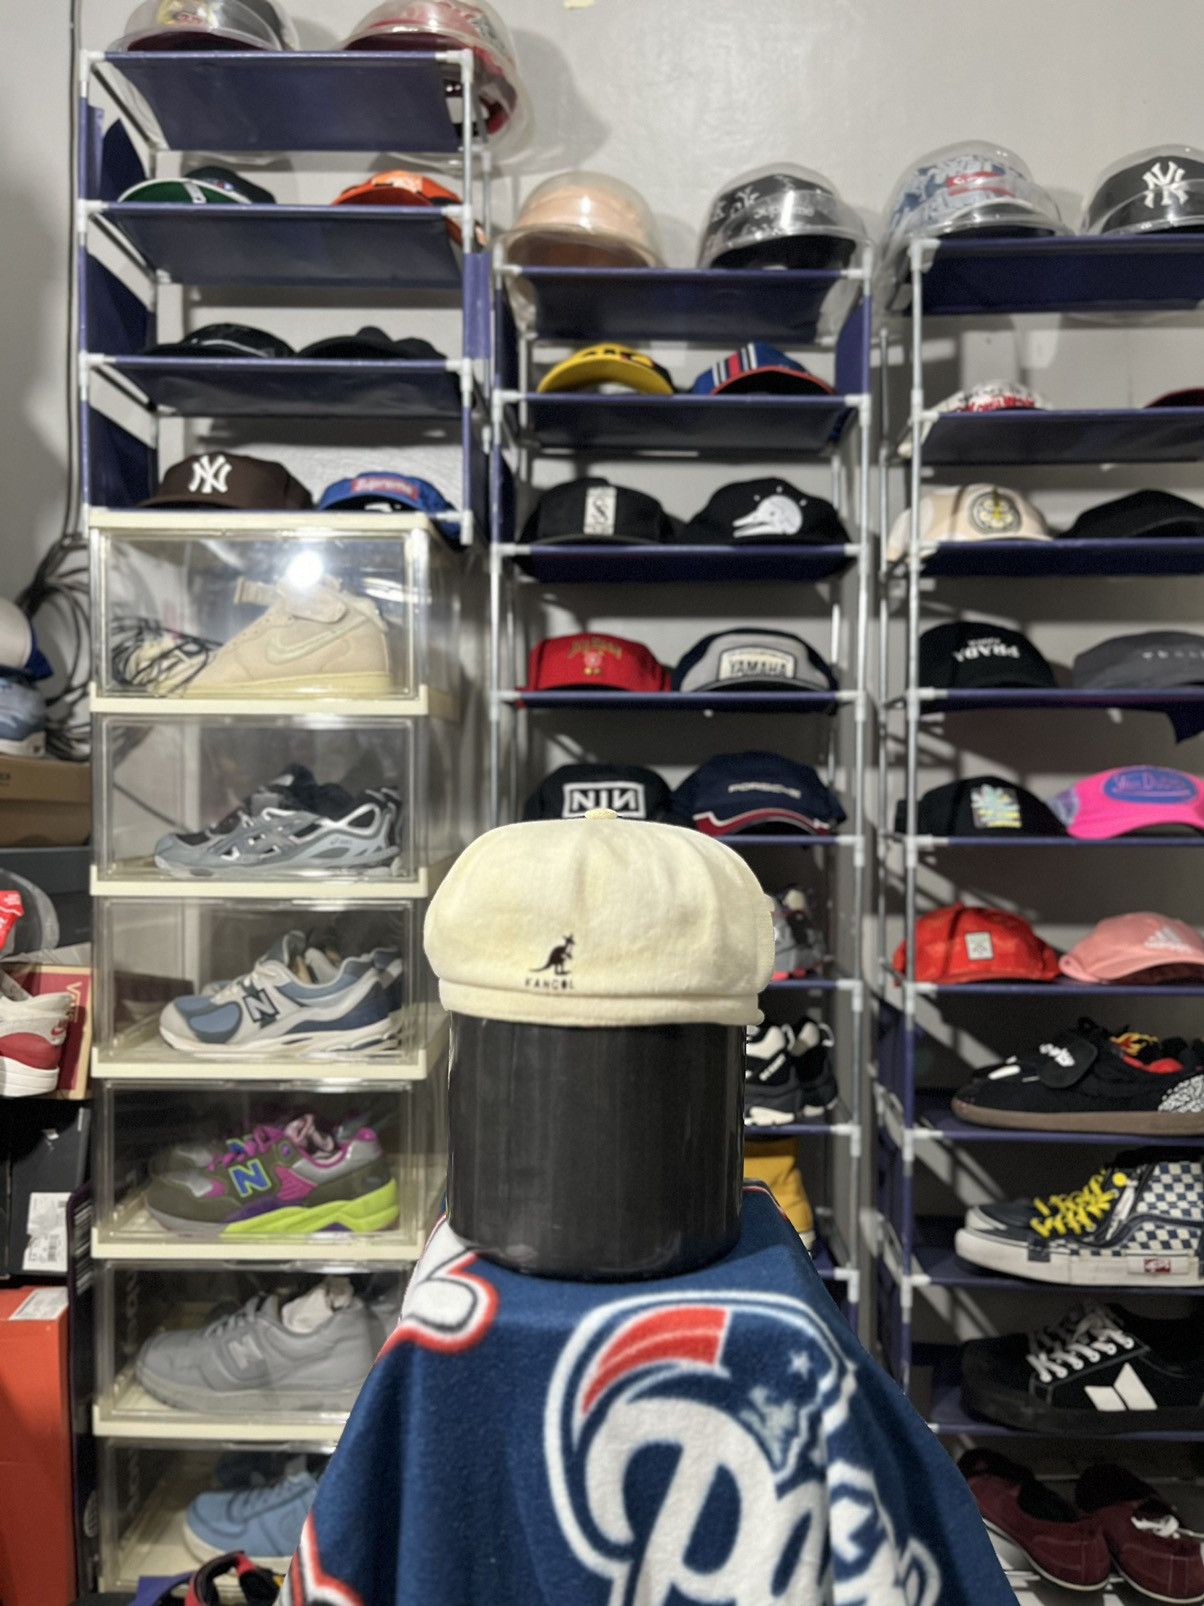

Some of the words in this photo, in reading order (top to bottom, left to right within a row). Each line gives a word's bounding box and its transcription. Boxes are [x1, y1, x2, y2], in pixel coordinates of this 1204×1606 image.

[1142, 161, 1187, 208] NY
[188, 454, 232, 494] NY
[729, 660, 787, 676] YAMAHA
[243, 988, 280, 1022] N
[228, 1158, 272, 1198] N
[228, 1334, 263, 1369] N
